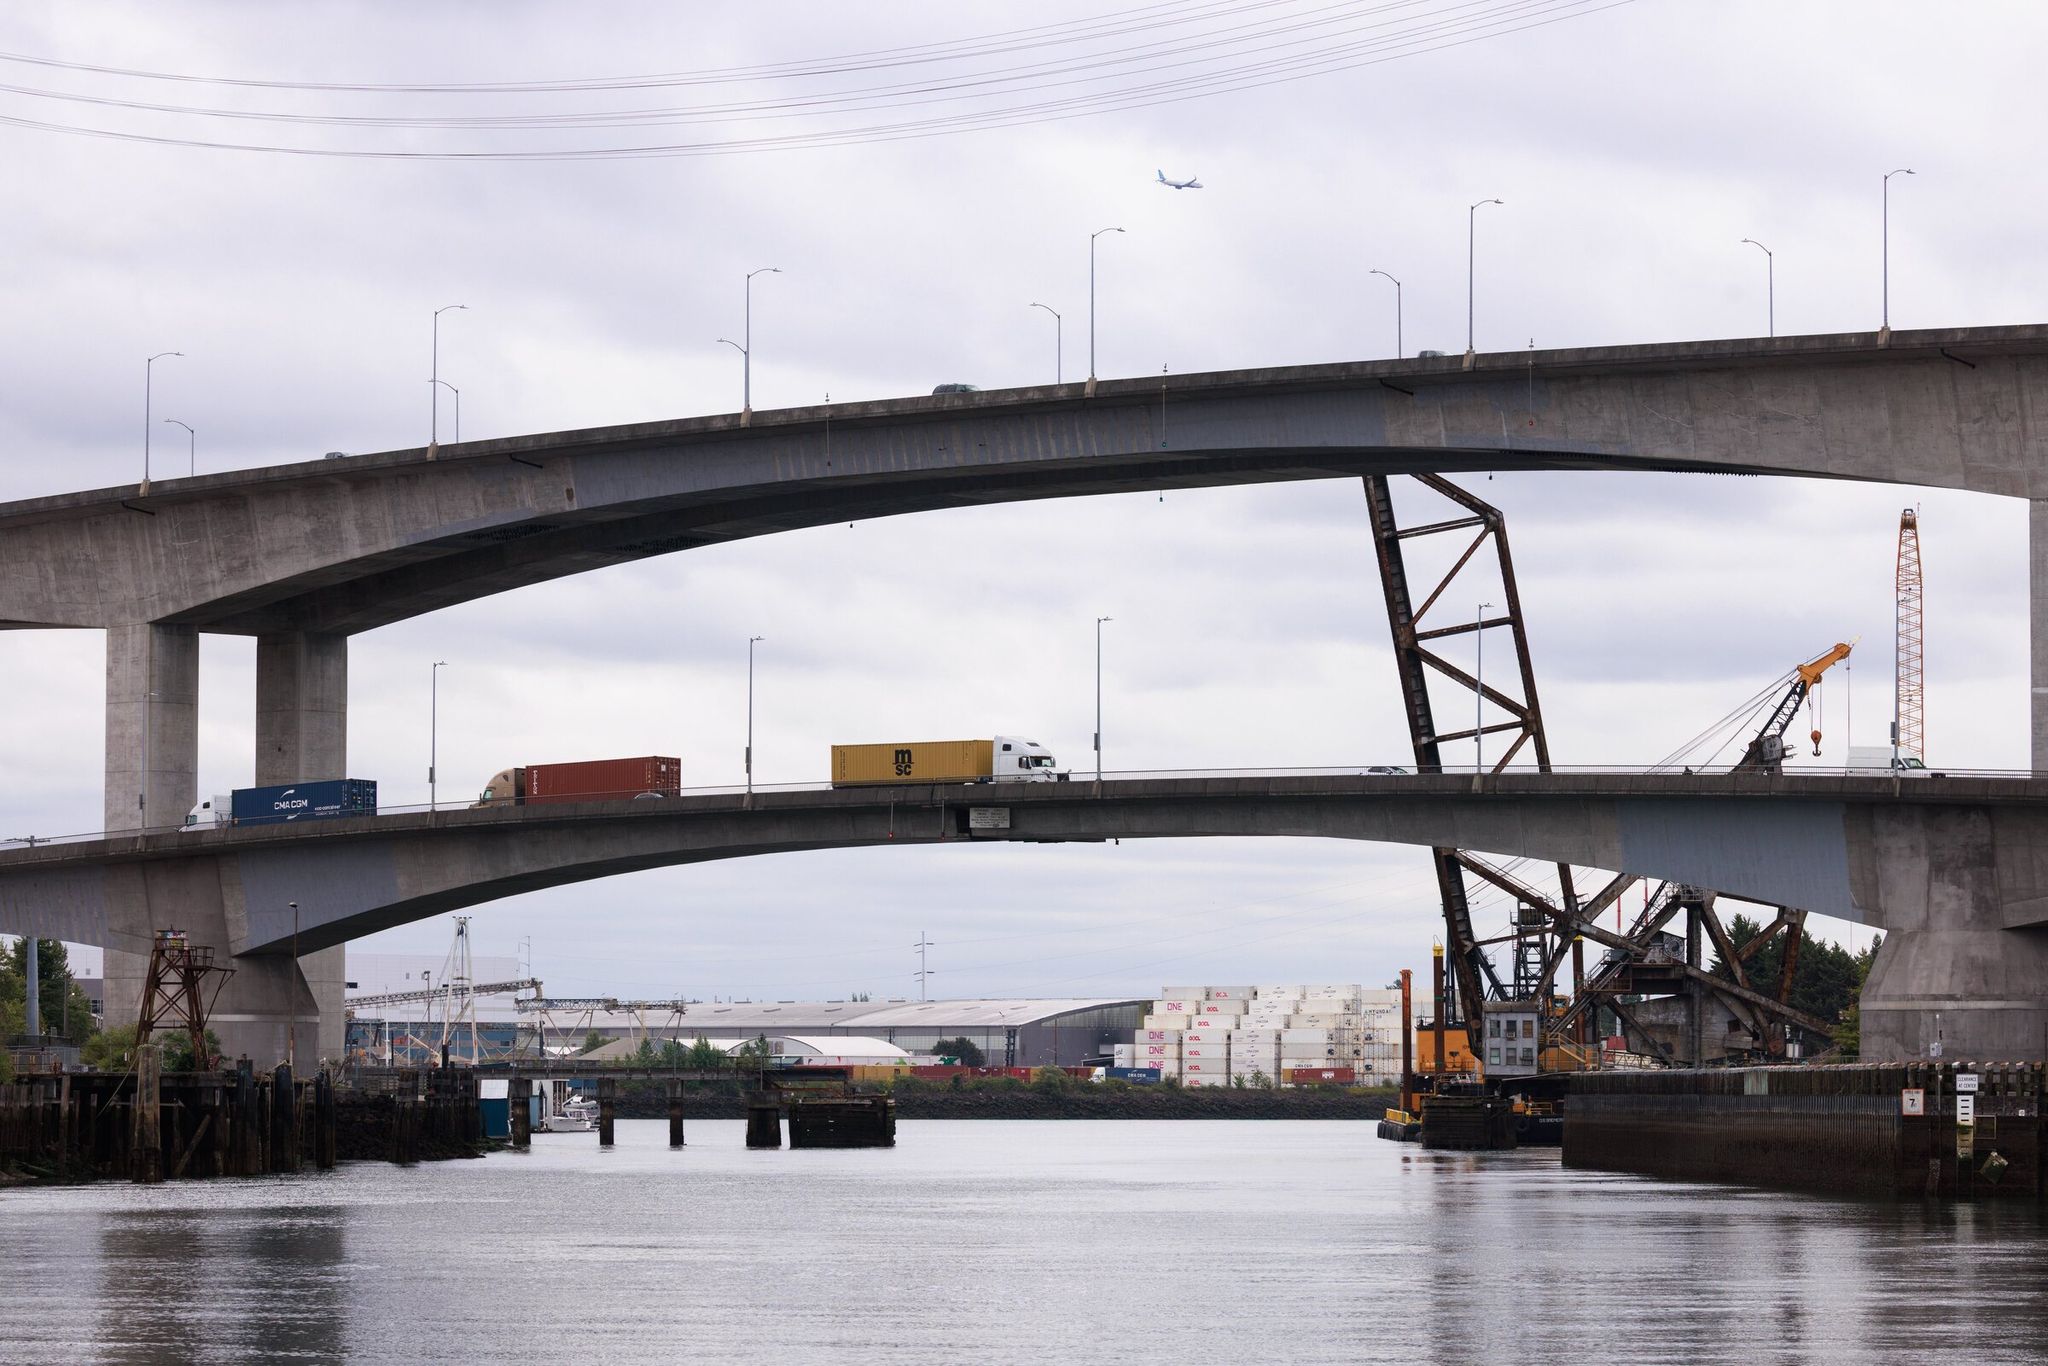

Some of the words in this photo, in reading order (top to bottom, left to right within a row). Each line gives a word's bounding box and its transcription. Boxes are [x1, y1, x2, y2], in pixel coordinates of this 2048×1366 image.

[274, 800, 290, 810] CMA
[291, 799, 308, 808] CGM
[1909, 1099, 1915, 1108] 7
